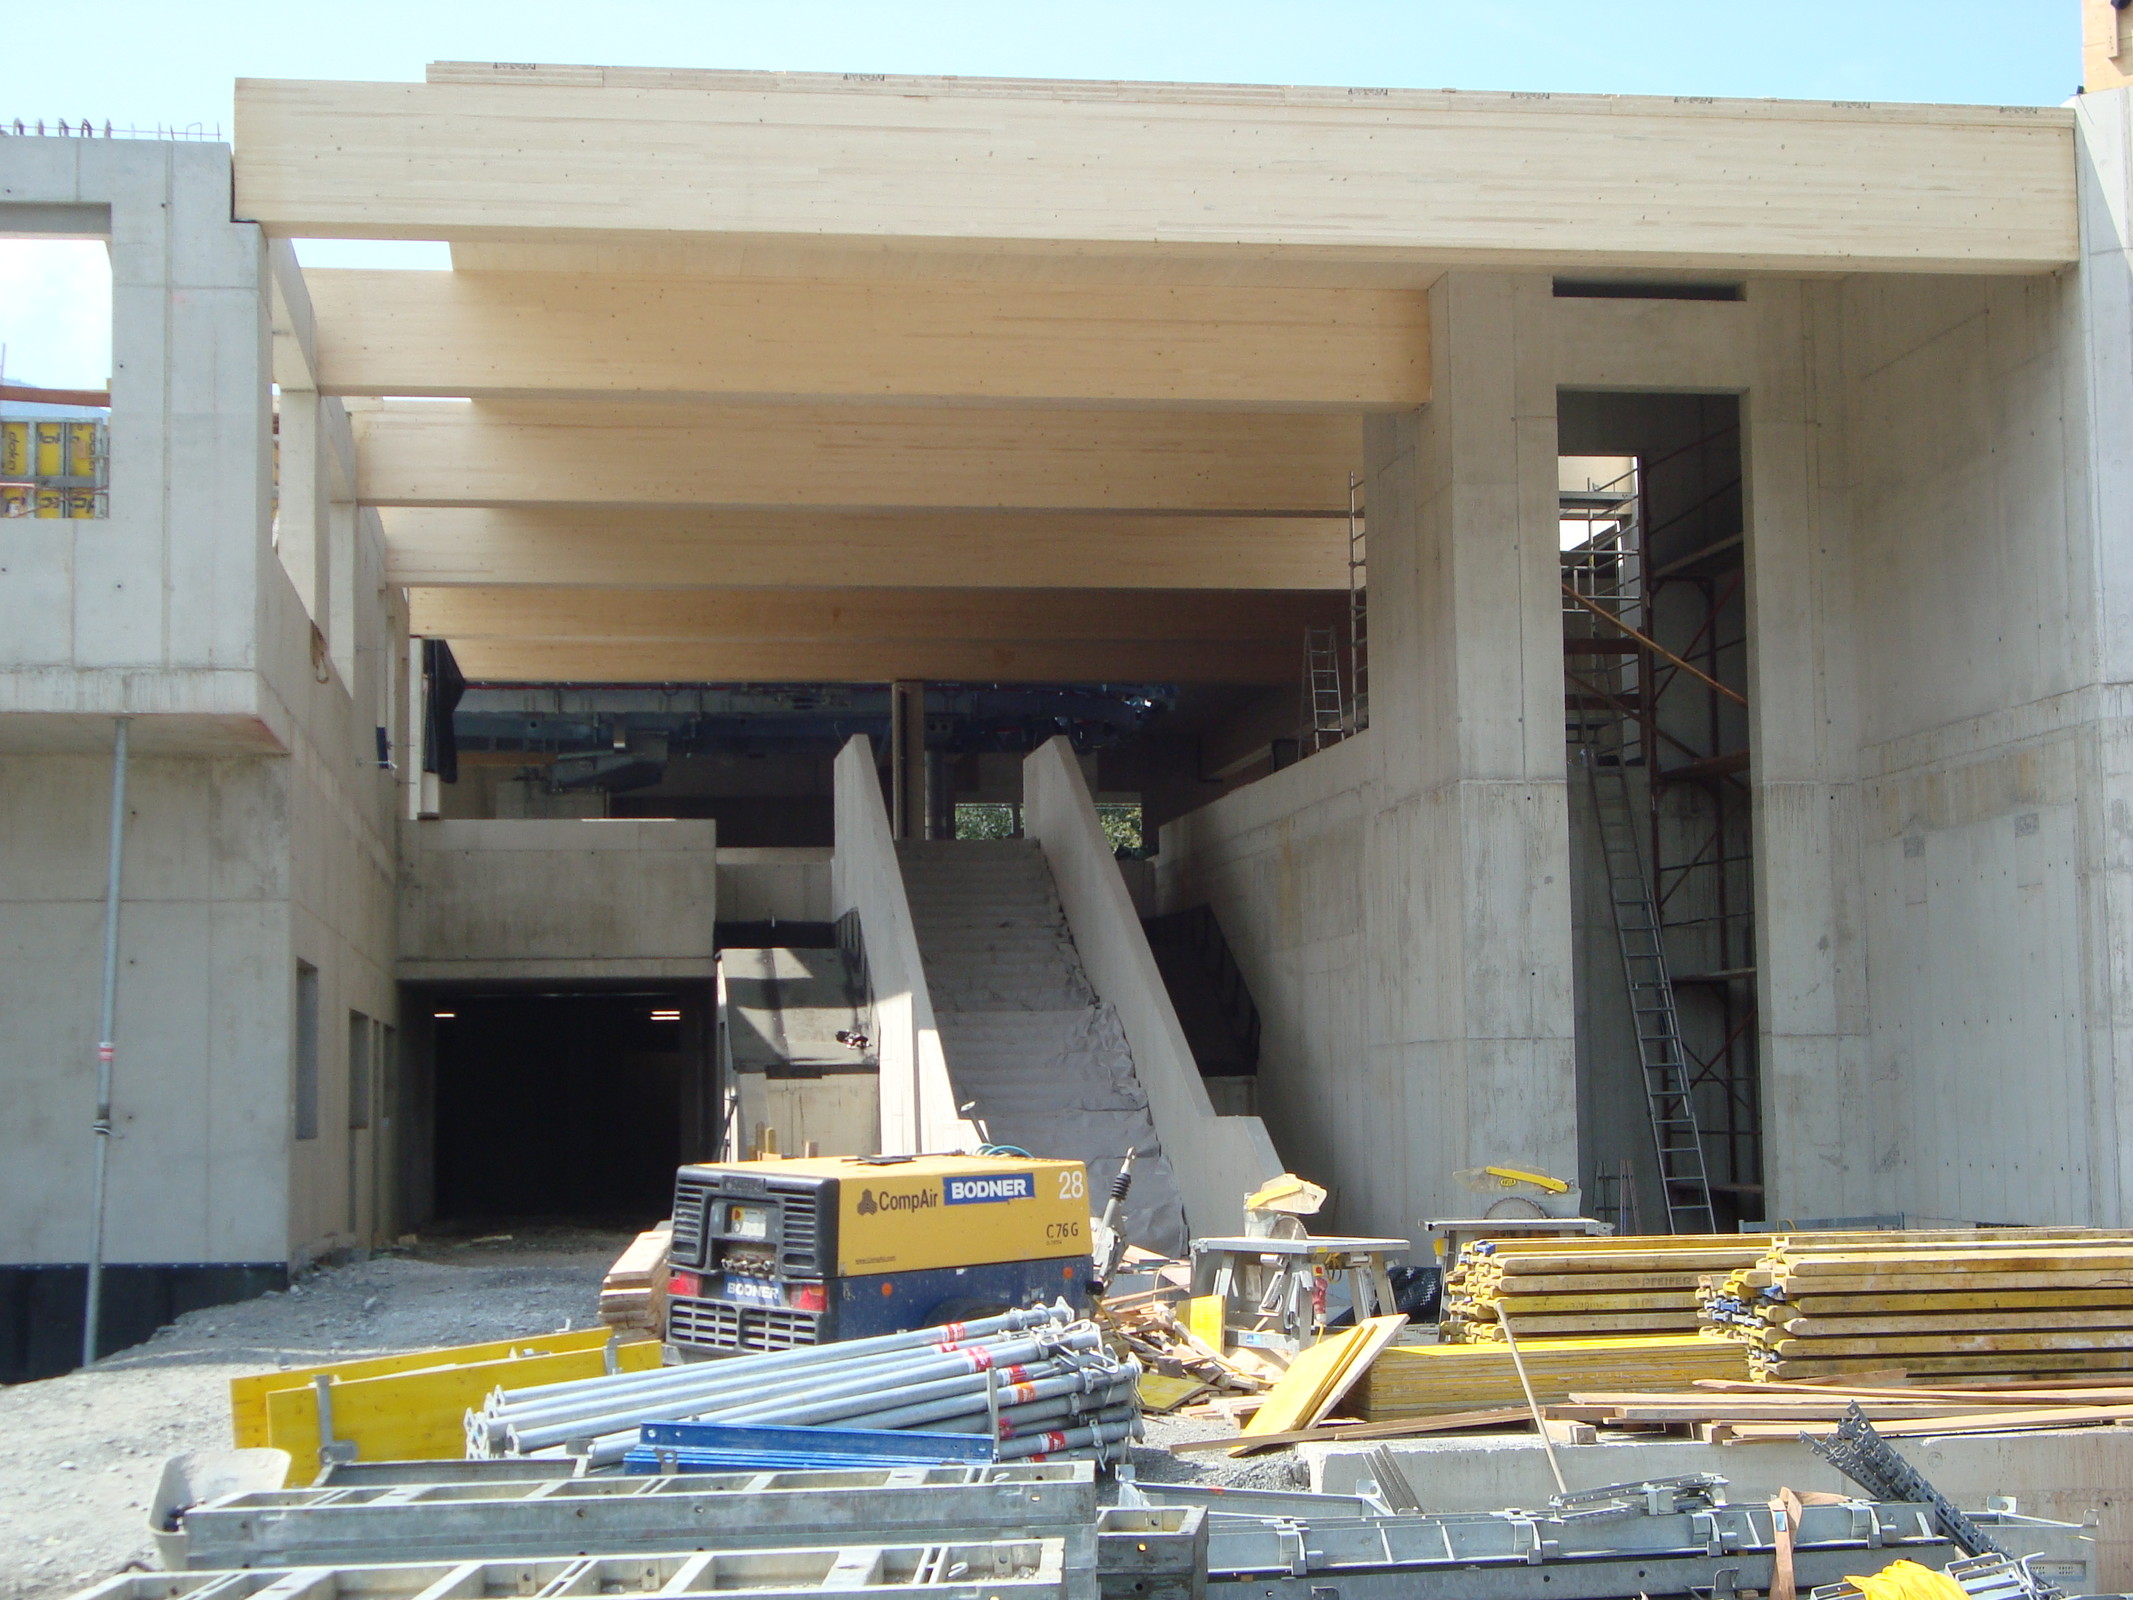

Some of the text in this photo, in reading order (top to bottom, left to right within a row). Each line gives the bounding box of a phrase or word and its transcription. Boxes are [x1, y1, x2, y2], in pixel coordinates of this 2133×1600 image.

[951, 1179, 1027, 1200] BODNER
[1059, 1171, 1084, 1200] 28
[879, 1188, 938, 1213] CompAir
[1056, 1222, 1069, 1238] 76
[1071, 1221, 1079, 1237] G
[727, 1282, 779, 1300] BODNER
[1641, 1276, 1693, 1287] PFEIFER
